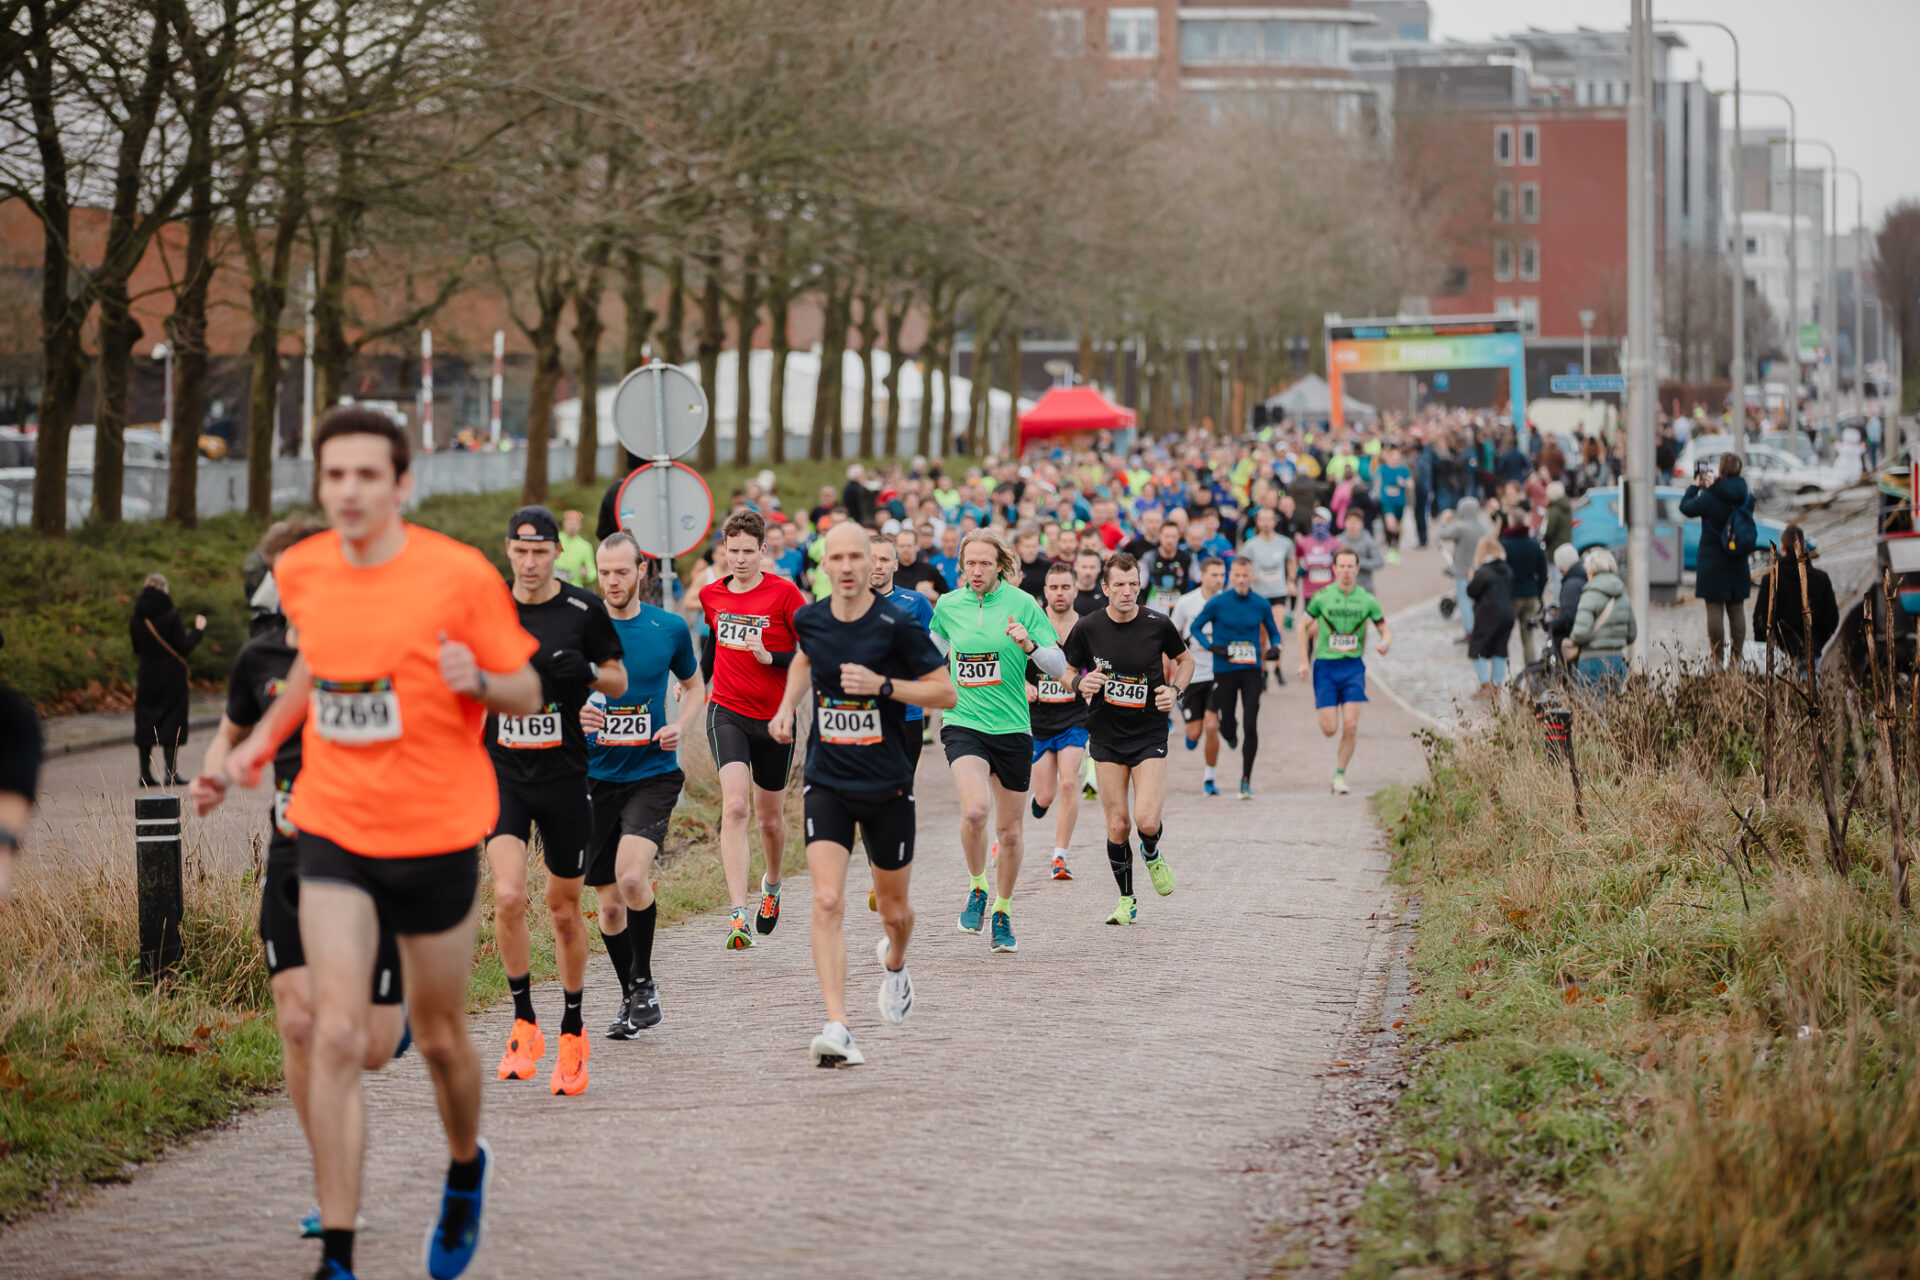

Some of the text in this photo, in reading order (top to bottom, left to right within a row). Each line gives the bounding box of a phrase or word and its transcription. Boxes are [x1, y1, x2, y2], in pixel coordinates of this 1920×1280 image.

[958, 662, 996, 679] 2307
[1041, 682, 1073, 695] 204
[1107, 681, 1145, 700] 2346
[503, 715, 556, 736] 4169
[824, 711, 875, 731] 2004
